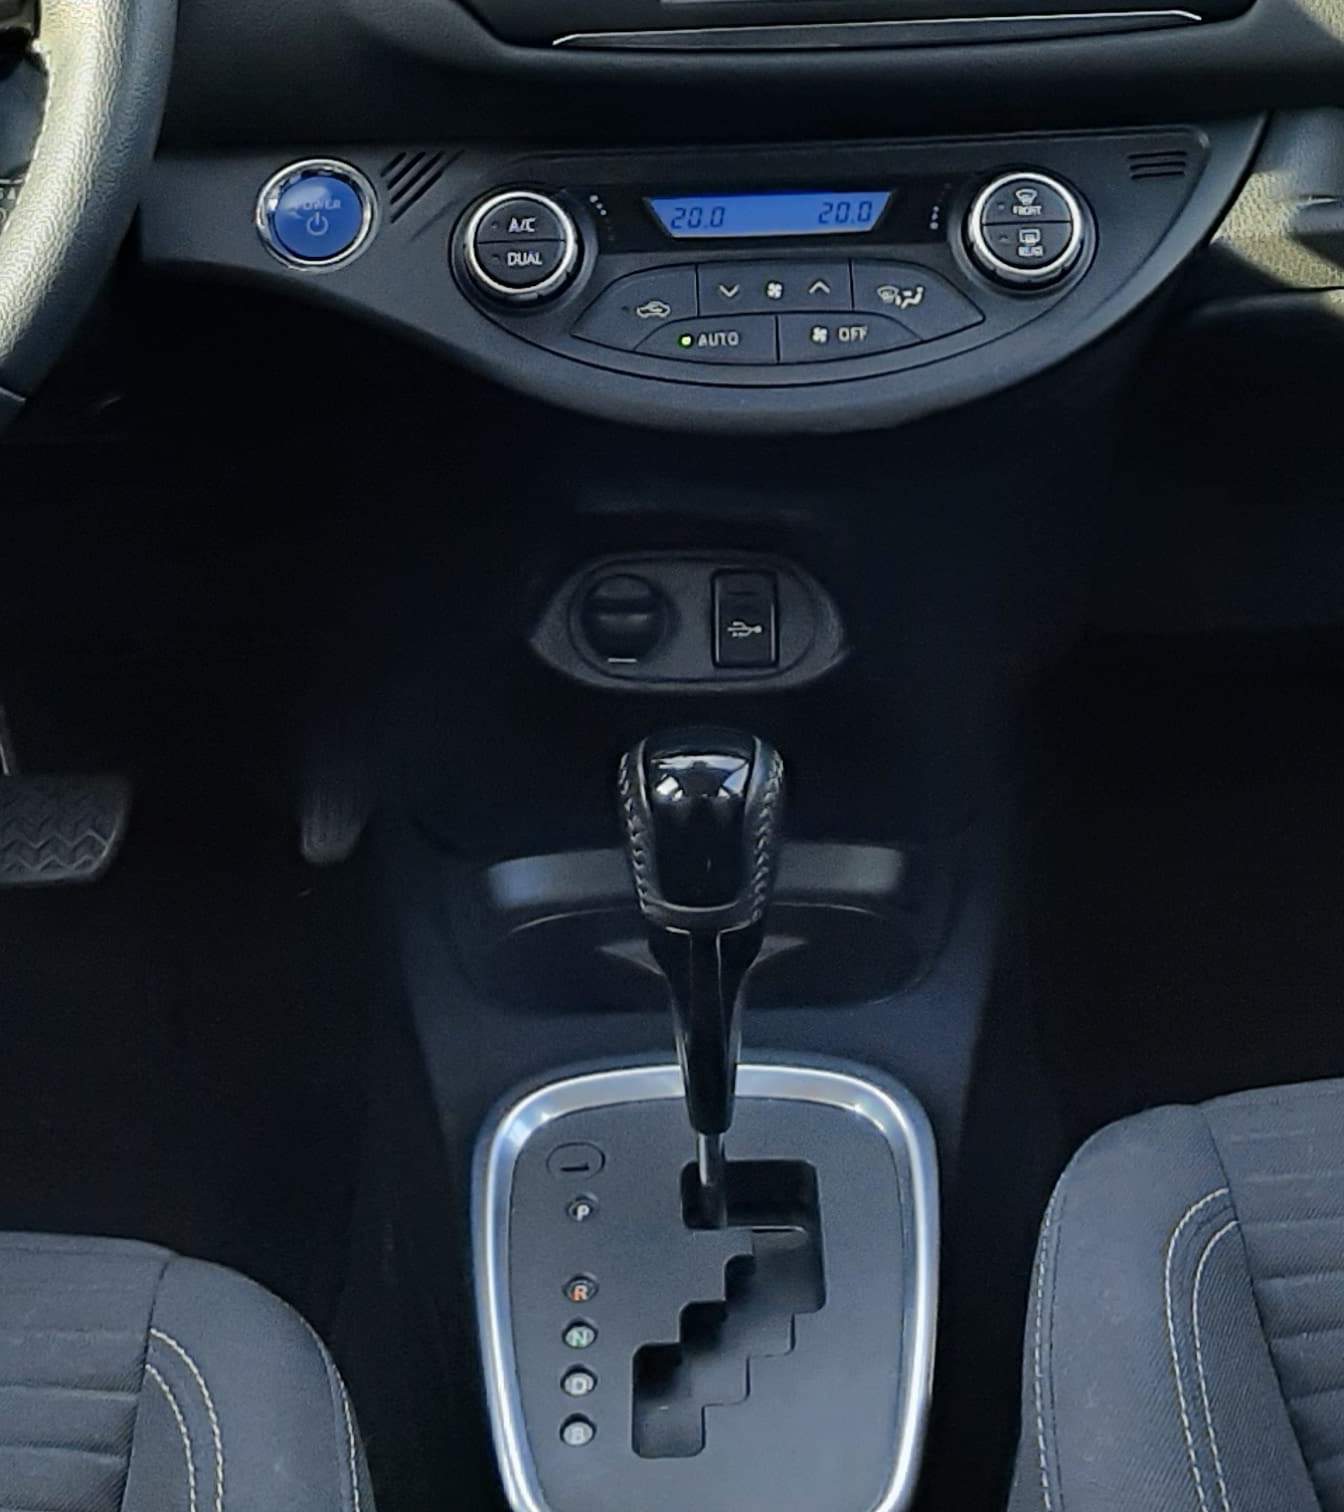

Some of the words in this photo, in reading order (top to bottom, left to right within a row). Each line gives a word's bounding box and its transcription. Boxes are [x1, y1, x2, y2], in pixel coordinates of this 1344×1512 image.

[293, 198, 342, 211] POWER
[818, 200, 873, 224] 20.0
[508, 217, 536, 233] A/C
[671, 206, 726, 230] 20.0
[507, 251, 543, 267] DUAL
[698, 331, 740, 348] AUTO
[838, 326, 868, 342] OFF
[575, 1205, 591, 1221] P
[570, 1284, 589, 1301] R
[570, 1330, 589, 1346] N
